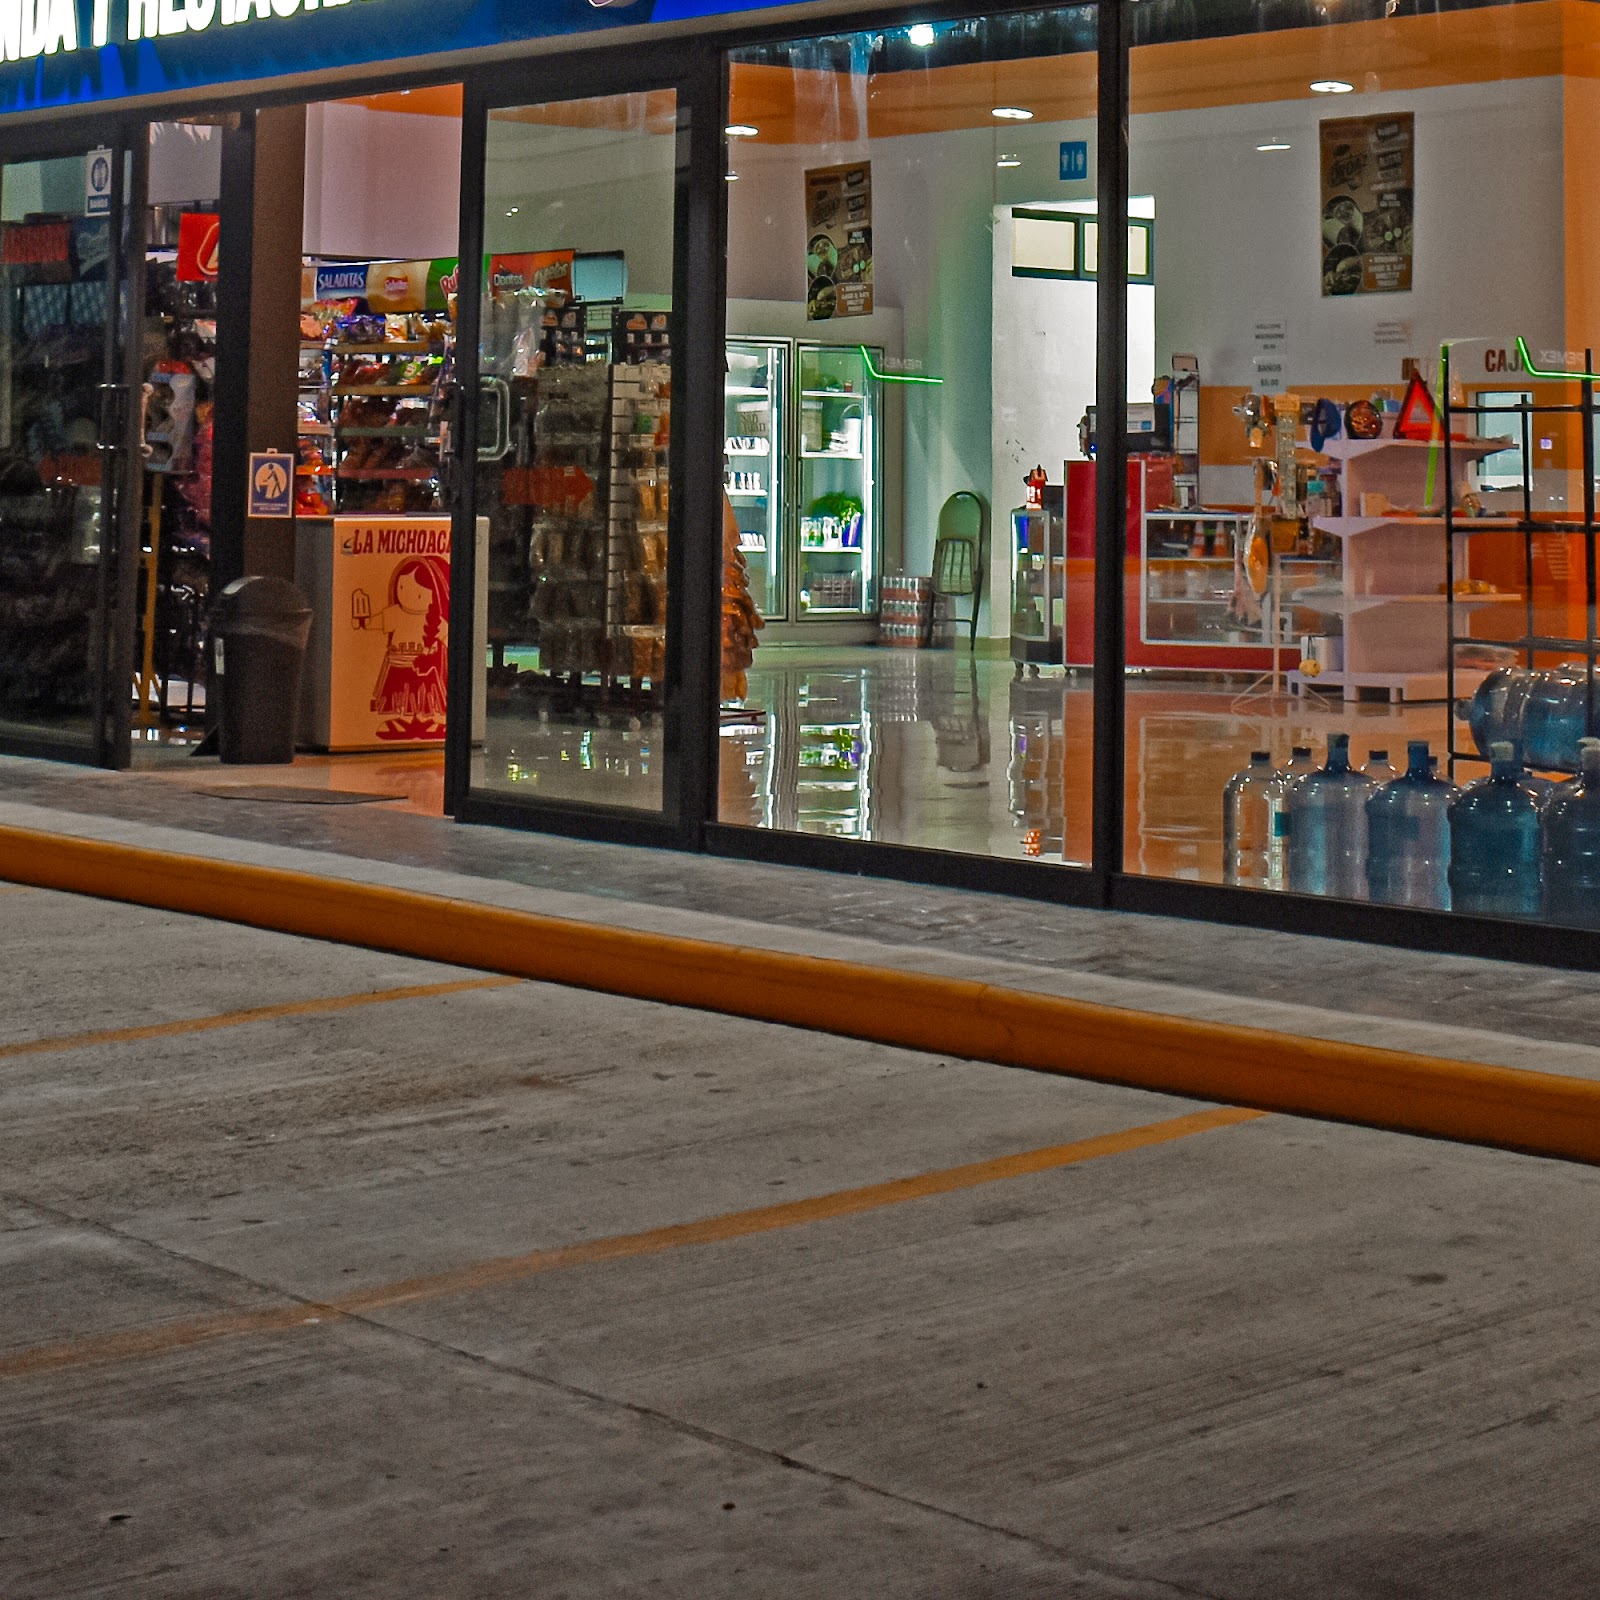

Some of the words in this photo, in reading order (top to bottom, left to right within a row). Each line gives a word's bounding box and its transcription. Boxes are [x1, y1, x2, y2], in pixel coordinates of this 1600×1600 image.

[319, 272, 365, 289] SALADITAS
[494, 273, 523, 286] Doritos
[353, 529, 373, 554] LA
